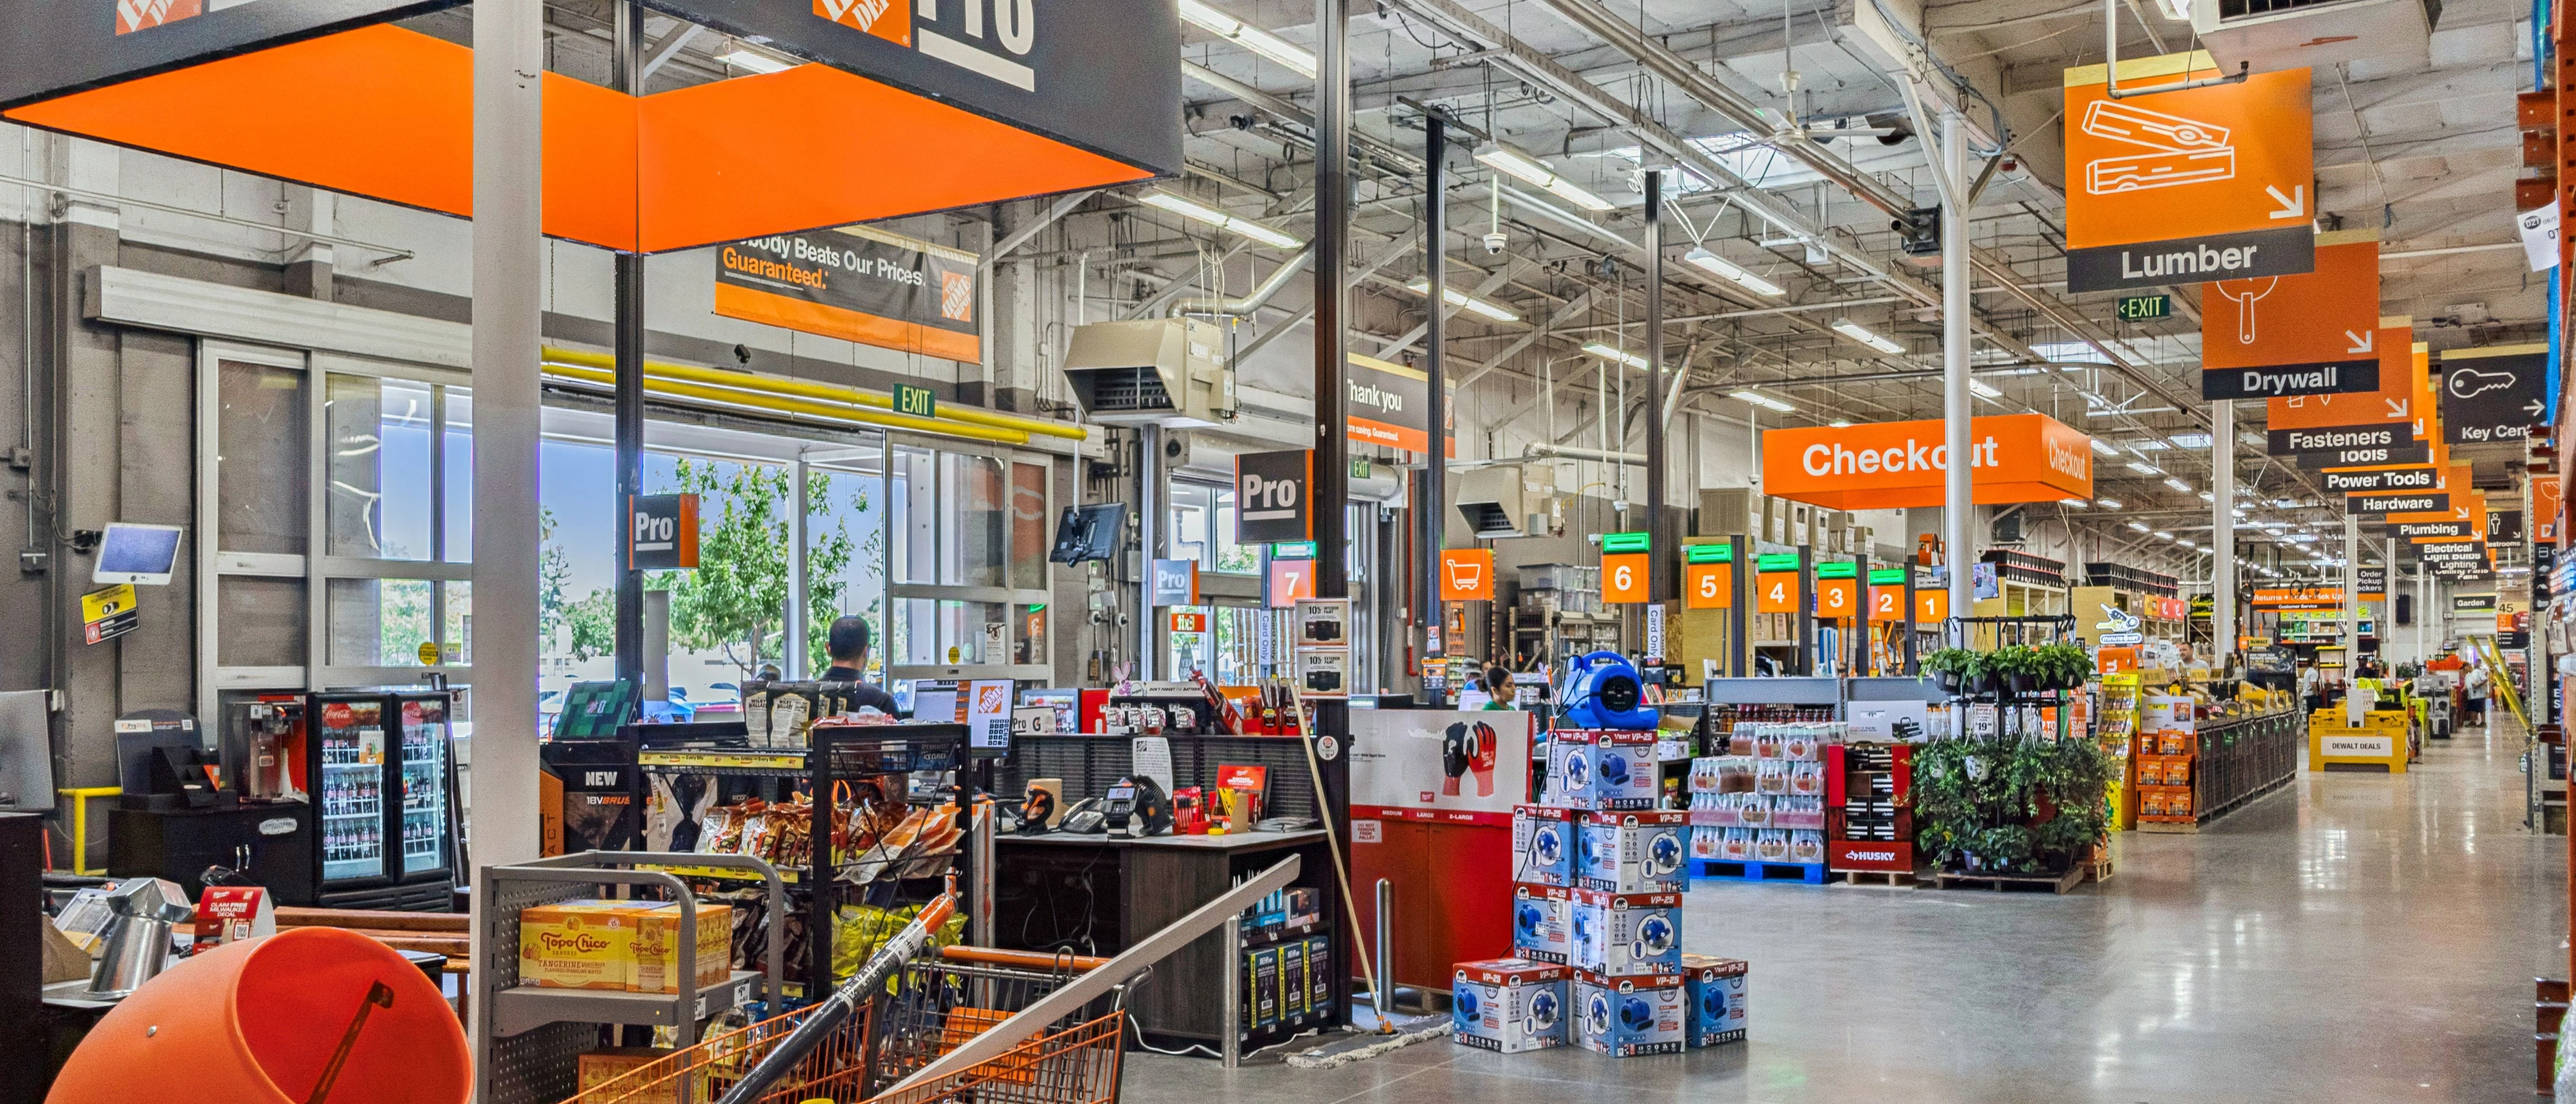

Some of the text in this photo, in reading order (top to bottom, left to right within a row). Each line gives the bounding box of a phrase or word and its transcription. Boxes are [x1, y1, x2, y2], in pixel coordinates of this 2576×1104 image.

[795, 238, 840, 267] Beats
[844, 251, 873, 274] Our
[2122, 243, 2257, 279] Lumber
[2128, 296, 2163, 317] EXIT
[2244, 367, 2337, 395] Drywall
[902, 386, 930, 415] EXIT
[1382, 391, 1402, 414] you
[2290, 431, 2392, 449] Fasteners
[2462, 427, 2491, 442] Key
[2048, 436, 2086, 481] Checkout
[1355, 460, 1368, 478] EXIT
[2328, 471, 2430, 489] Power Tools
[1243, 474, 1296, 509] Pro
[2363, 497, 2433, 511] Hardware
[635, 512, 674, 541] Pro
[2400, 524, 2458, 535] Plumbing
[2424, 543, 2473, 553] Electrical
[2440, 561, 2477, 570] Lighting
[1157, 570, 1185, 588] Pro
[1285, 572, 1299, 596] 7
[1614, 565, 1632, 591] 6
[1700, 575, 1717, 598] 5
[1770, 582, 1785, 603] 4
[1829, 587, 1844, 608] 3
[1879, 593, 1893, 612] 2
[1925, 597, 1936, 616] 1
[2498, 603, 2513, 613] 45
[1649, 635, 1658, 657] Only
[978, 685, 1003, 714] HOME
[1013, 718, 1027, 730] Pro
[1573, 732, 1589, 741] VP-25
[1631, 733, 1653, 741] VP-25
[585, 771, 618, 786] NEW
[1602, 814, 1616, 824] VP-25
[1660, 814, 1683, 823] VP-25
[1859, 852, 1895, 861] HUSKY
[1547, 888, 1567, 898] VP-25
[1650, 896, 1674, 905] VP-25
[541, 932, 611, 952] Topo Chico
[630, 942, 671, 955] Topo Chico
[538, 960, 581, 968] TANGERINE
[1728, 964, 1744, 973] VP-25
[1482, 972, 1501, 982] VP-25
[1540, 969, 1559, 979] VP-25
[1656, 975, 1680, 985] VP-25
